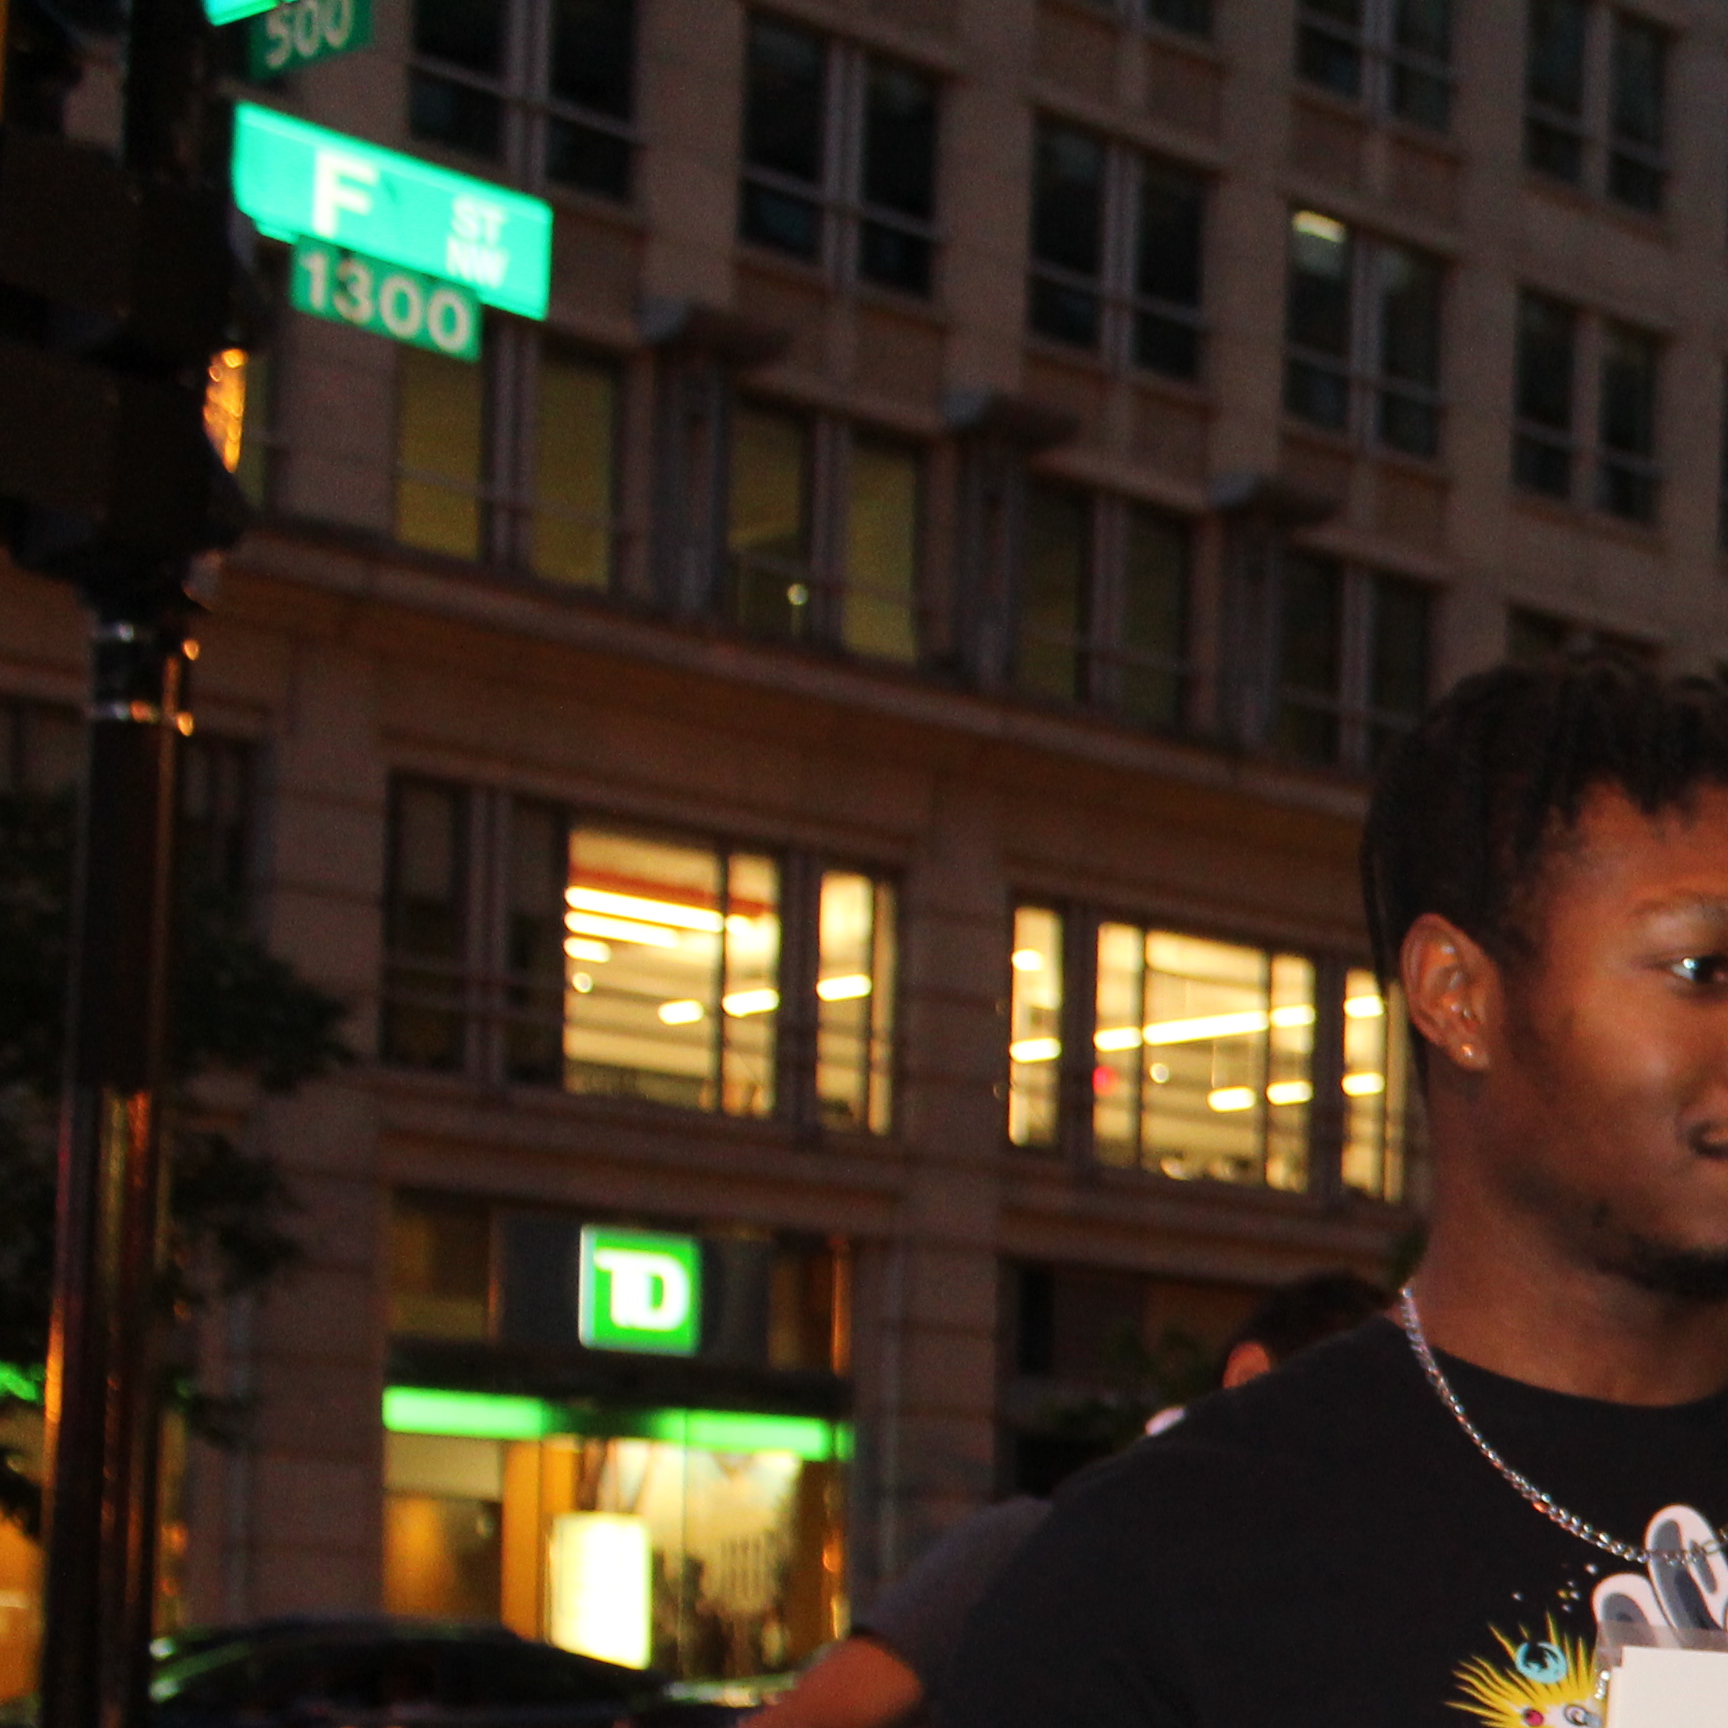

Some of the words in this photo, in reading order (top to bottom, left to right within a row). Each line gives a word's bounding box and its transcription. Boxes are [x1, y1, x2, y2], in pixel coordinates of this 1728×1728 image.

[264, 0, 355, 68] 500
[311, 150, 382, 240] F
[452, 197, 510, 247] ST
[301, 252, 470, 352] 1300
[445, 233, 511, 289] NW
[593, 1247, 691, 1332] TD
